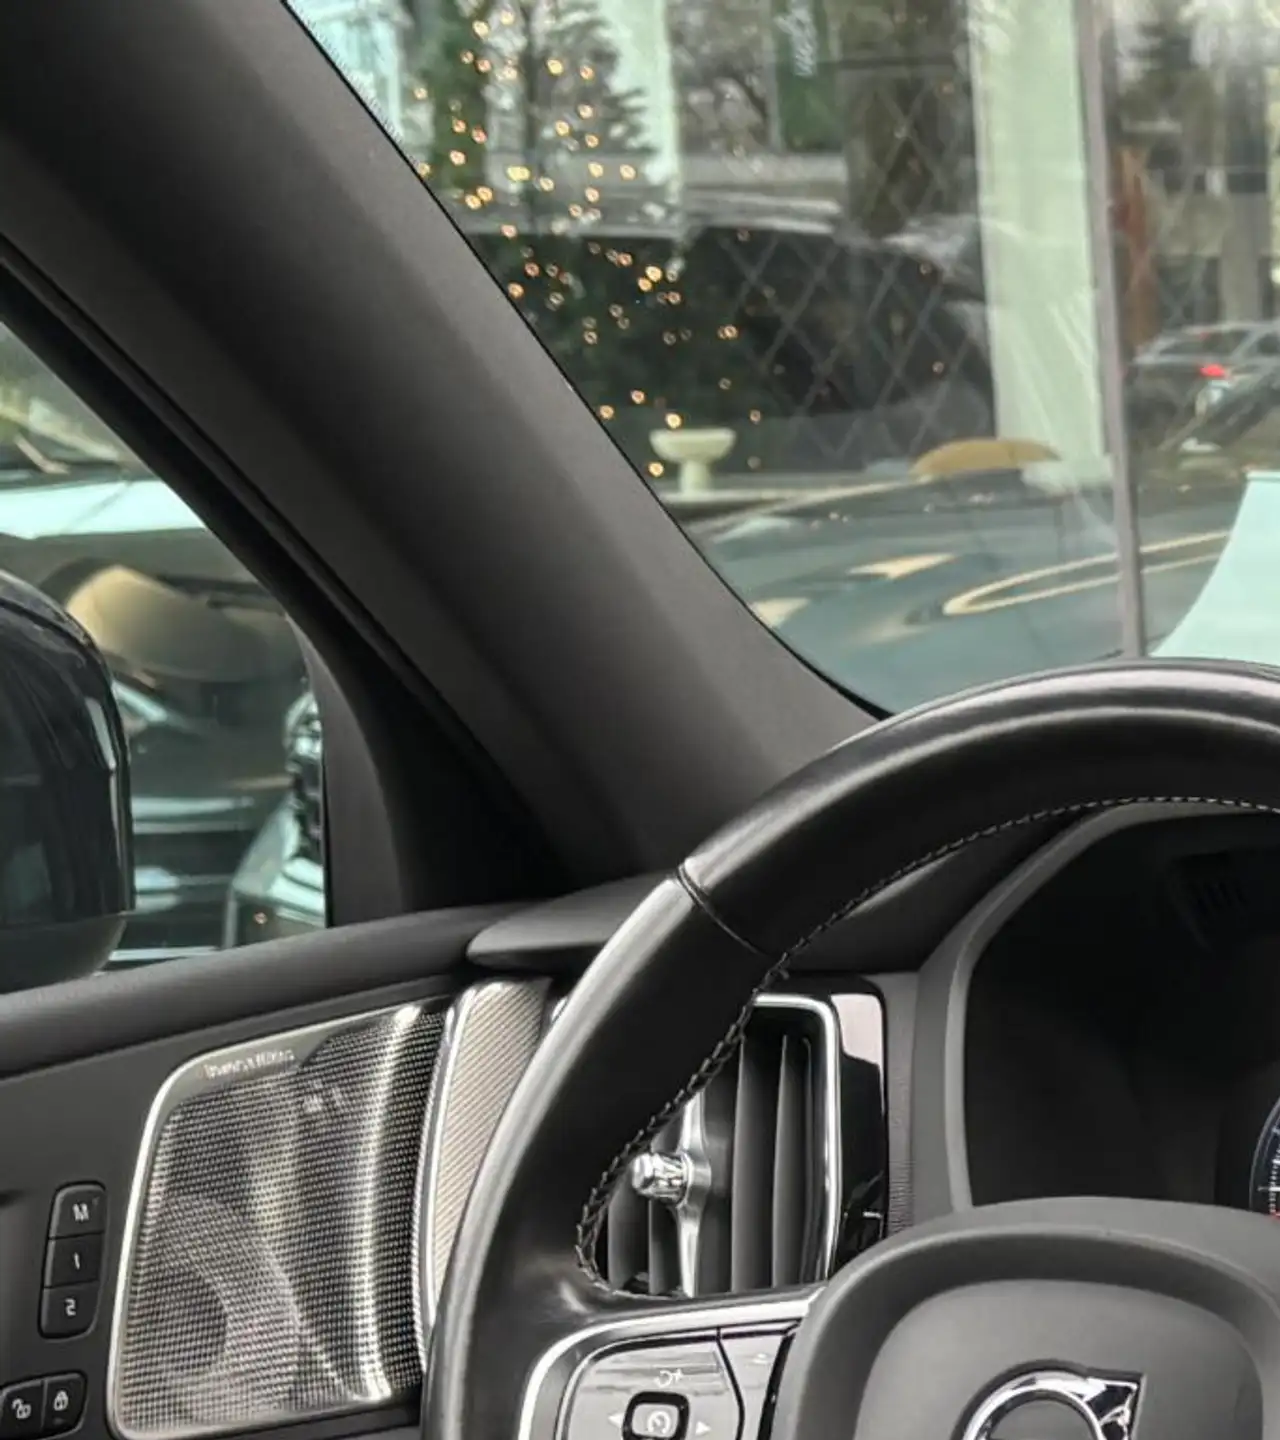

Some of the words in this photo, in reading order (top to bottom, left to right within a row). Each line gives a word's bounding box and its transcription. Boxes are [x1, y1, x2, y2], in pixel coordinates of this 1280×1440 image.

[72, 1203, 89, 1222] M
[74, 1252, 80, 1270] 1
[65, 1297, 77, 1317] 2
